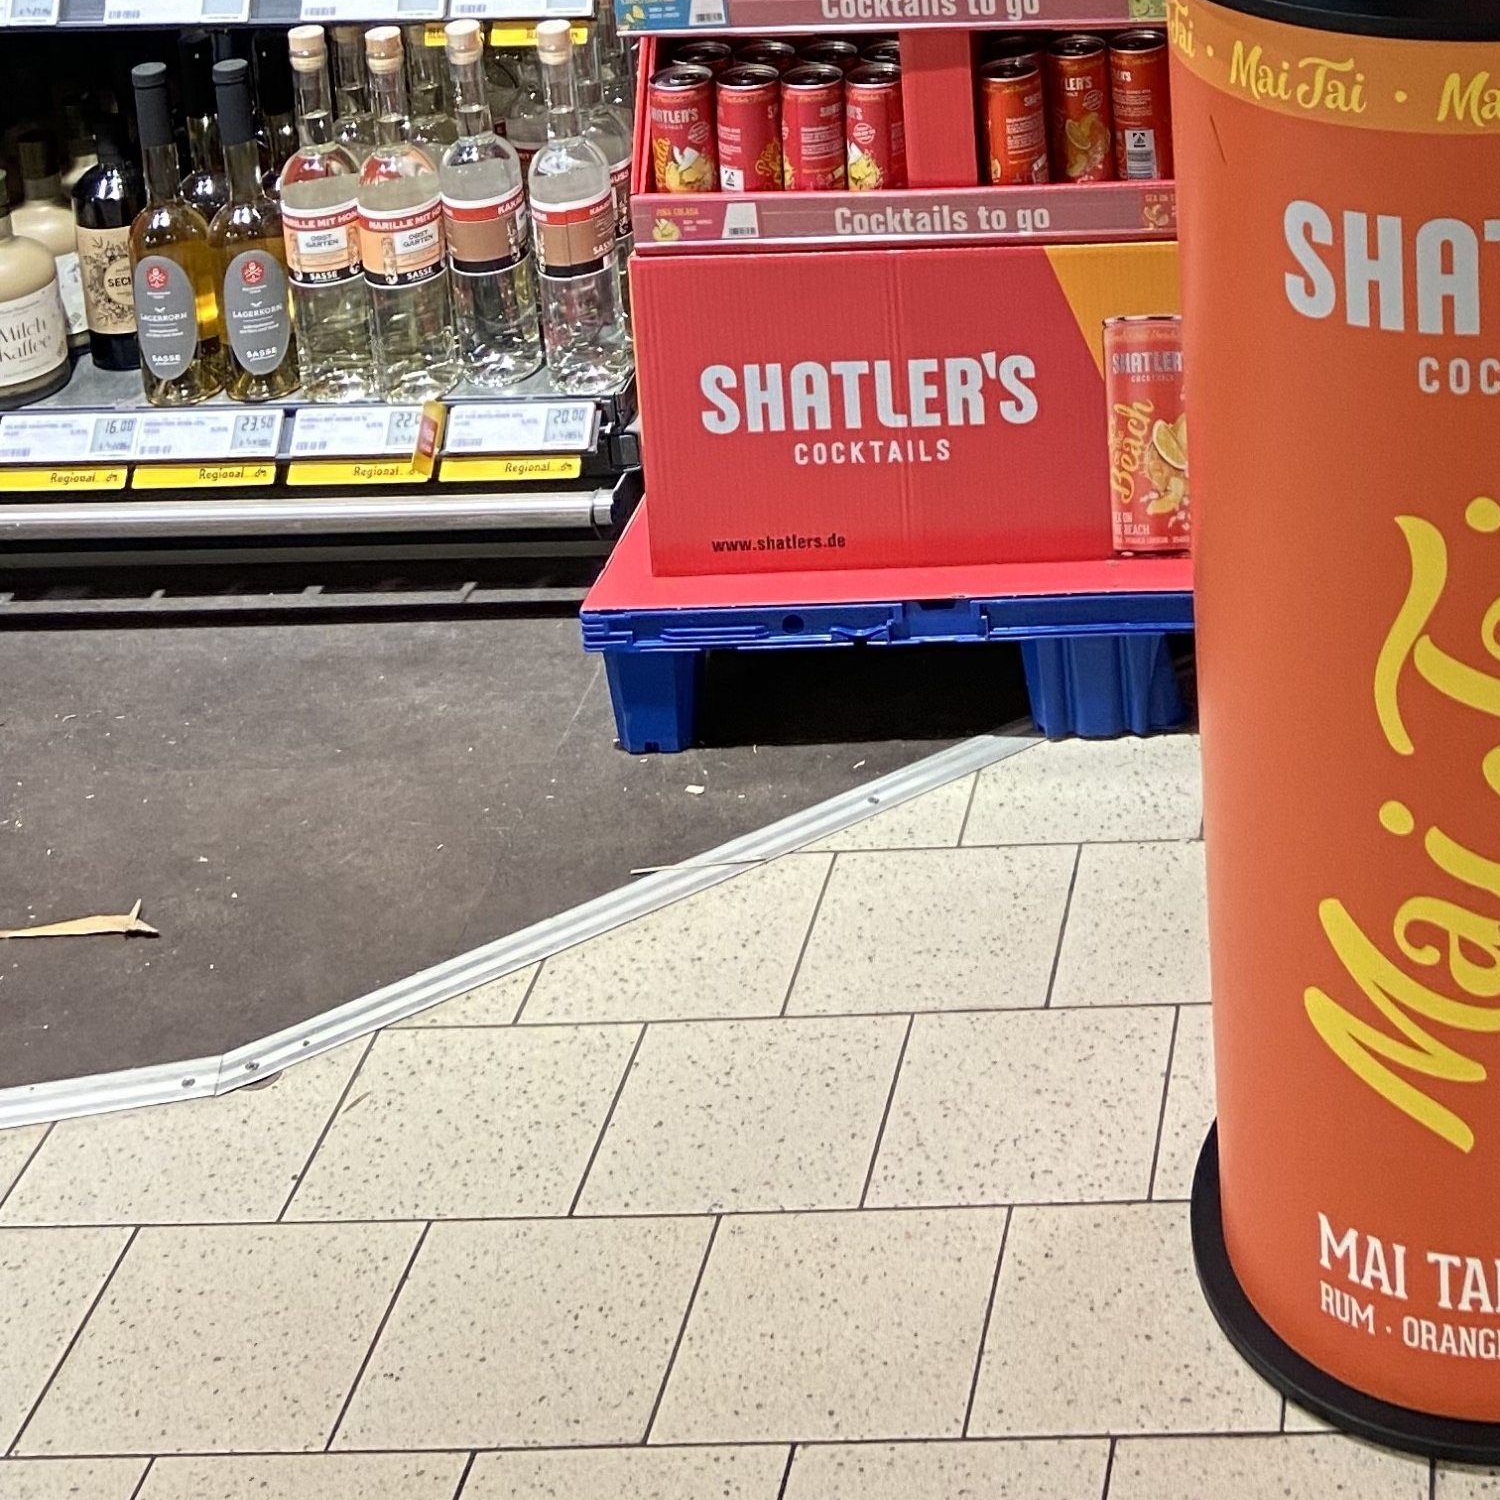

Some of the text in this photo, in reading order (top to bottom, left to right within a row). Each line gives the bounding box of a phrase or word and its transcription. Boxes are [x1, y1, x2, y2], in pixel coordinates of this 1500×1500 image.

[1229, 40, 1367, 114] Mai Tai
[369, 217, 413, 231] MARILLE
[414, 213, 431, 226] MIT
[835, 205, 1050, 237] Cocktails to go
[310, 232, 333, 242] OBST
[402, 234, 434, 248] GARTEN
[408, 230, 429, 242] OBST
[305, 239, 339, 249] GARTEN
[310, 270, 338, 280] SASSE
[406, 265, 434, 280] SASSE
[140, 312, 188, 323] LAGERKORN
[232, 303, 283, 319] LAGERKORN
[151, 353, 182, 363] SASSE
[246, 346, 277, 359] SASSE
[700, 352, 1039, 435] SHATLER'S
[241, 416, 274, 432] 23.50
[553, 409, 584, 424] 20.00
[104, 420, 134, 435] 16.00
[794, 438, 951, 466] COCKTAILS
[1110, 397, 1155, 505] Beach
[199, 466, 245, 480] Regional
[354, 466, 399, 478] Regional
[505, 462, 550, 474] Regional
[50, 471, 95, 485] Regional
[712, 533, 846, 553] www.shatlers.de
[1317, 1211, 1408, 1300] MAI
[1319, 1280, 1376, 1336] RUM
